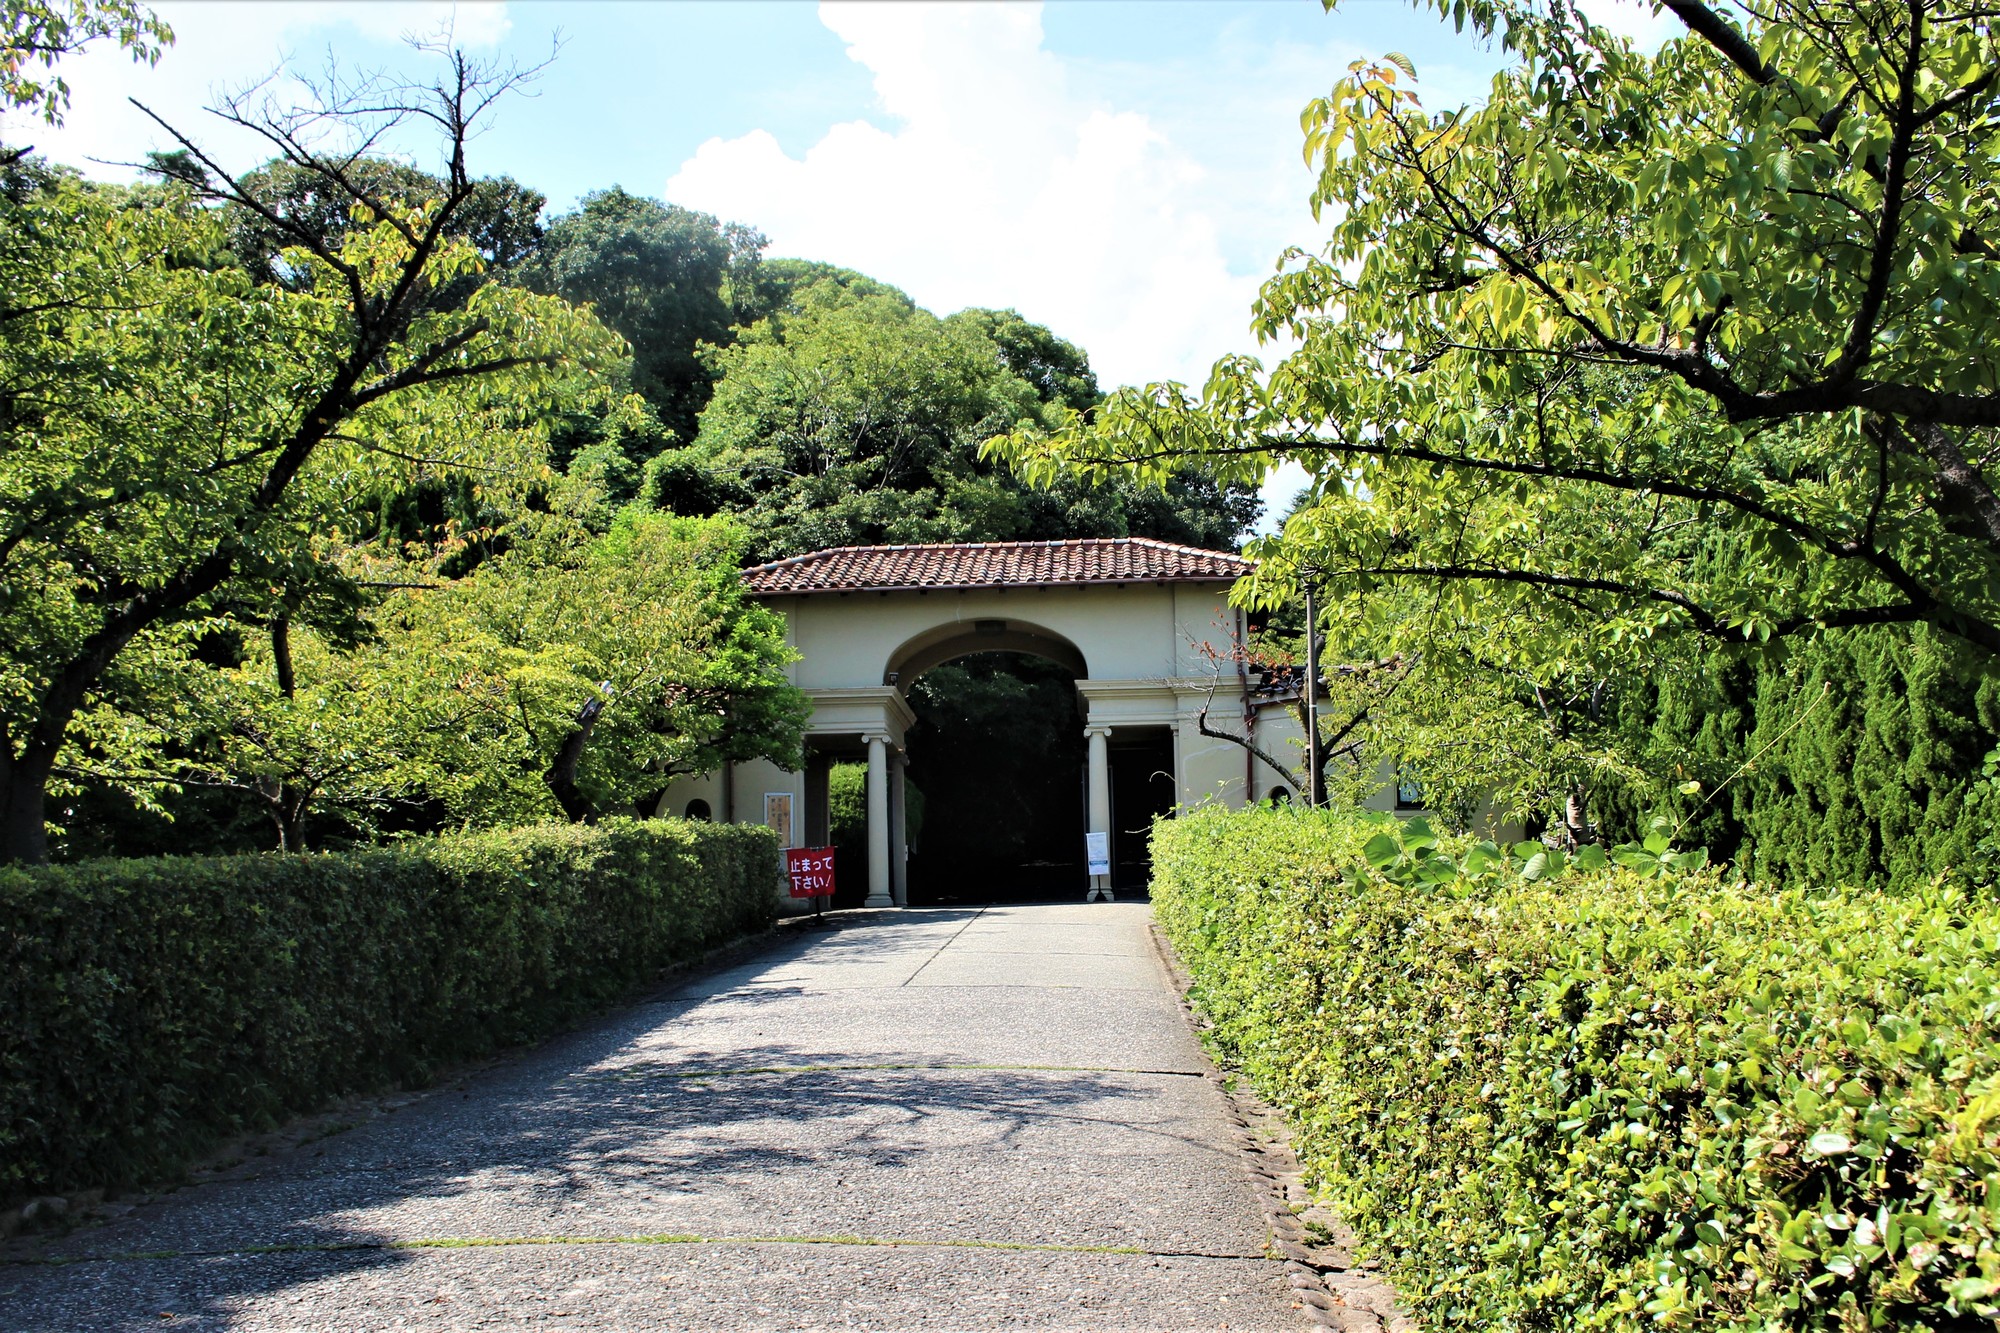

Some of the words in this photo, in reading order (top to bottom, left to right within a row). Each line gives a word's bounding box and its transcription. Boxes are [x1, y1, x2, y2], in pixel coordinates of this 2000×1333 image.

[791, 857, 832, 872] 止まって
[792, 874, 832, 890] 下さい!
